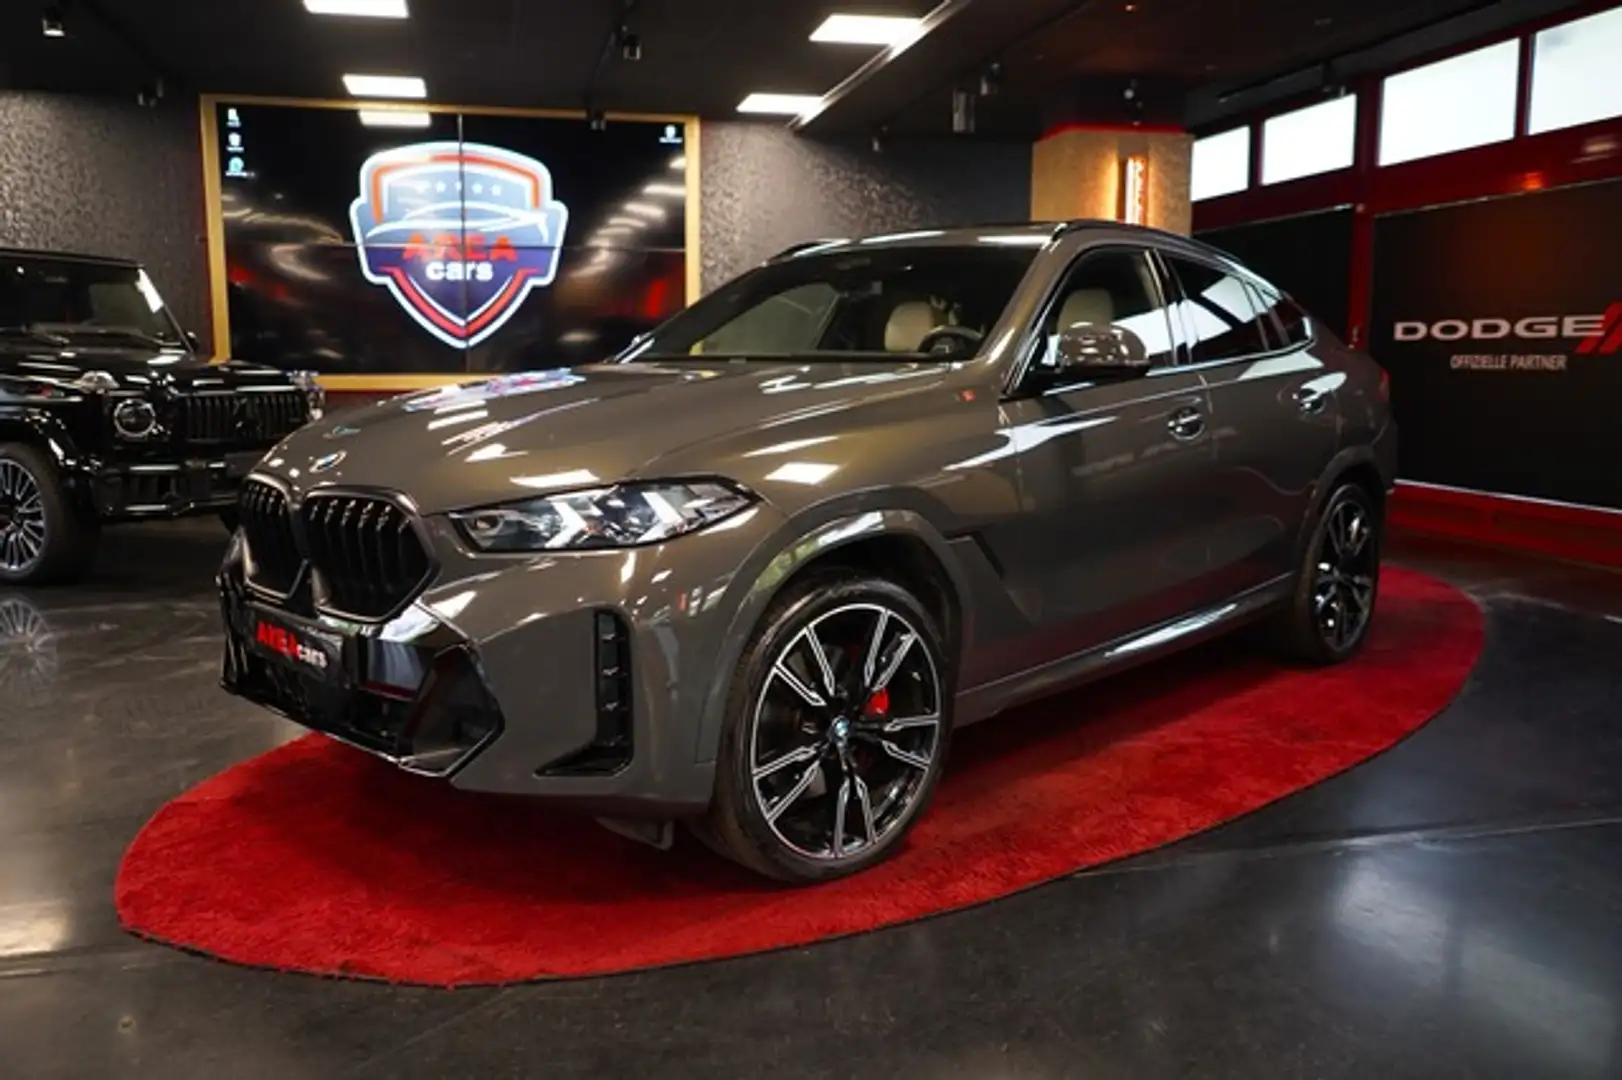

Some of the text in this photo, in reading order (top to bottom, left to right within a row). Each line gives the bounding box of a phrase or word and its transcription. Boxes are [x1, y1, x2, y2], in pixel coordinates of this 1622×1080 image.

[402, 233, 517, 262] AREA
[425, 261, 493, 281] cars
[1394, 314, 1605, 341] DODGE
[1510, 354, 1567, 370] PARTNER
